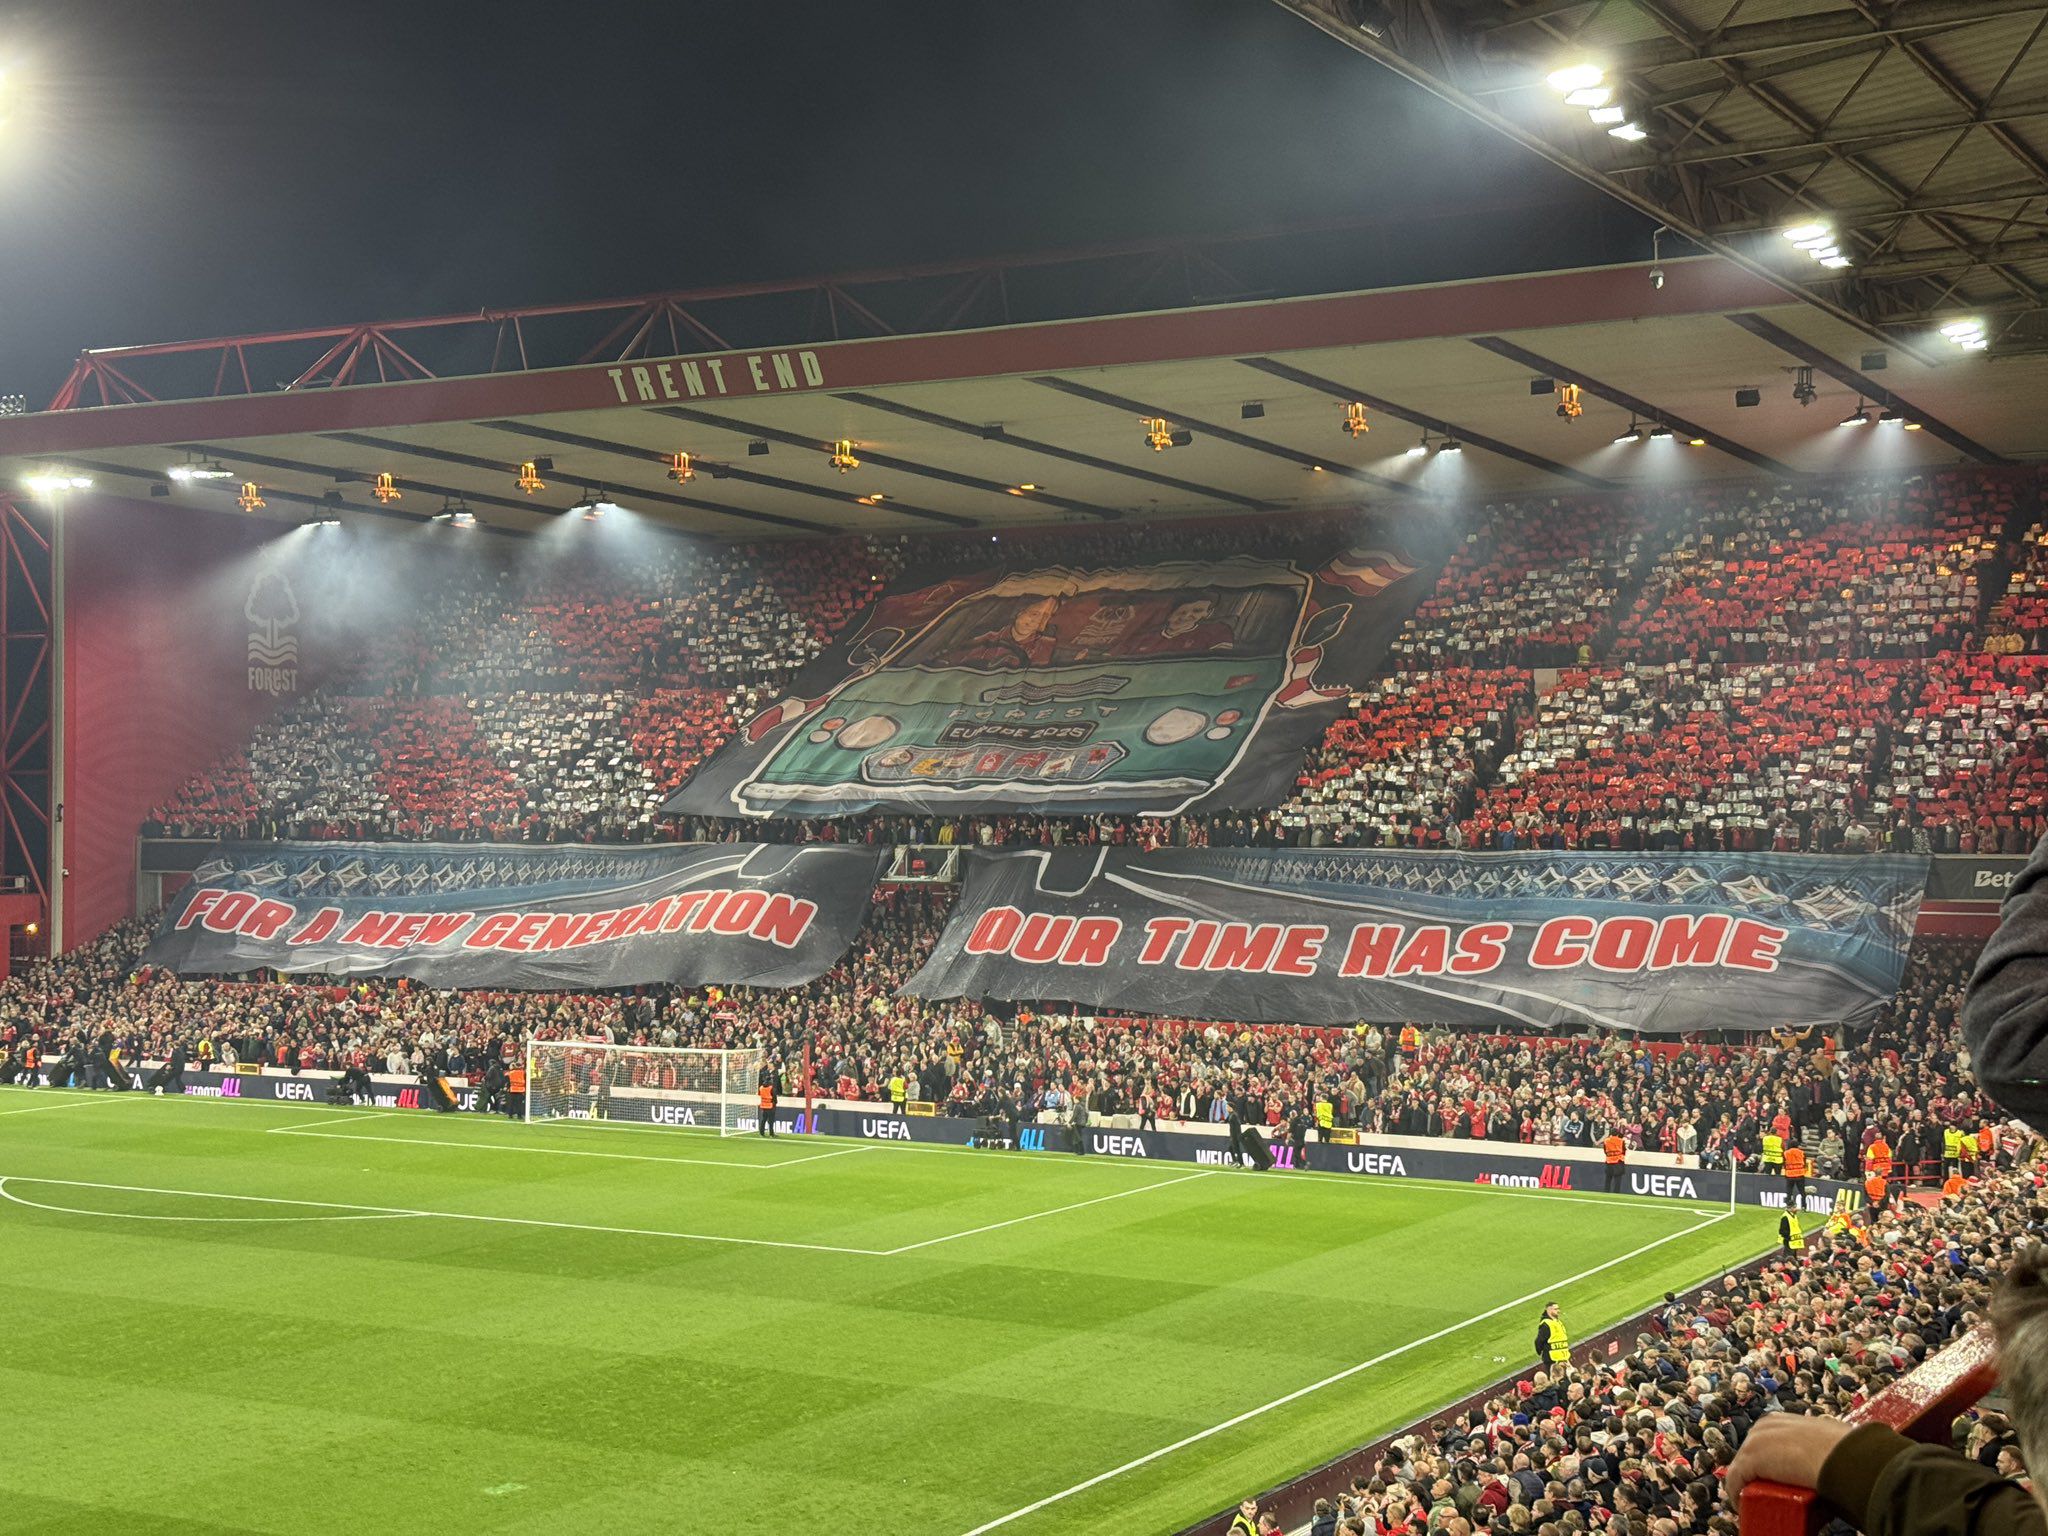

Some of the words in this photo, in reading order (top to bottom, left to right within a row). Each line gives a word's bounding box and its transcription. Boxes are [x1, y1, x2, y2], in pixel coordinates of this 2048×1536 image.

[608, 360, 727, 402] TRENT
[748, 351, 824, 391] END
[949, 706, 1119, 720] FOREST
[1030, 727, 1086, 739] 2025
[175, 889, 297, 940] FOR
[286, 907, 343, 945] A
[338, 911, 476, 949] NEW
[463, 890, 818, 953] GENERATION
[964, 905, 1123, 967] OUR
[1138, 917, 1329, 976] TIME
[1338, 922, 1513, 978] HAS
[1528, 914, 1789, 973] COME
[275, 1082, 314, 1100] UEFA
[398, 1088, 419, 1108] ALL
[652, 1105, 695, 1125] UEFA
[863, 1118, 911, 1140] UEFA
[1093, 1134, 1146, 1157] UEFA
[1347, 1151, 1407, 1176] UEFA
[1631, 1173, 1697, 1198] UEFA
